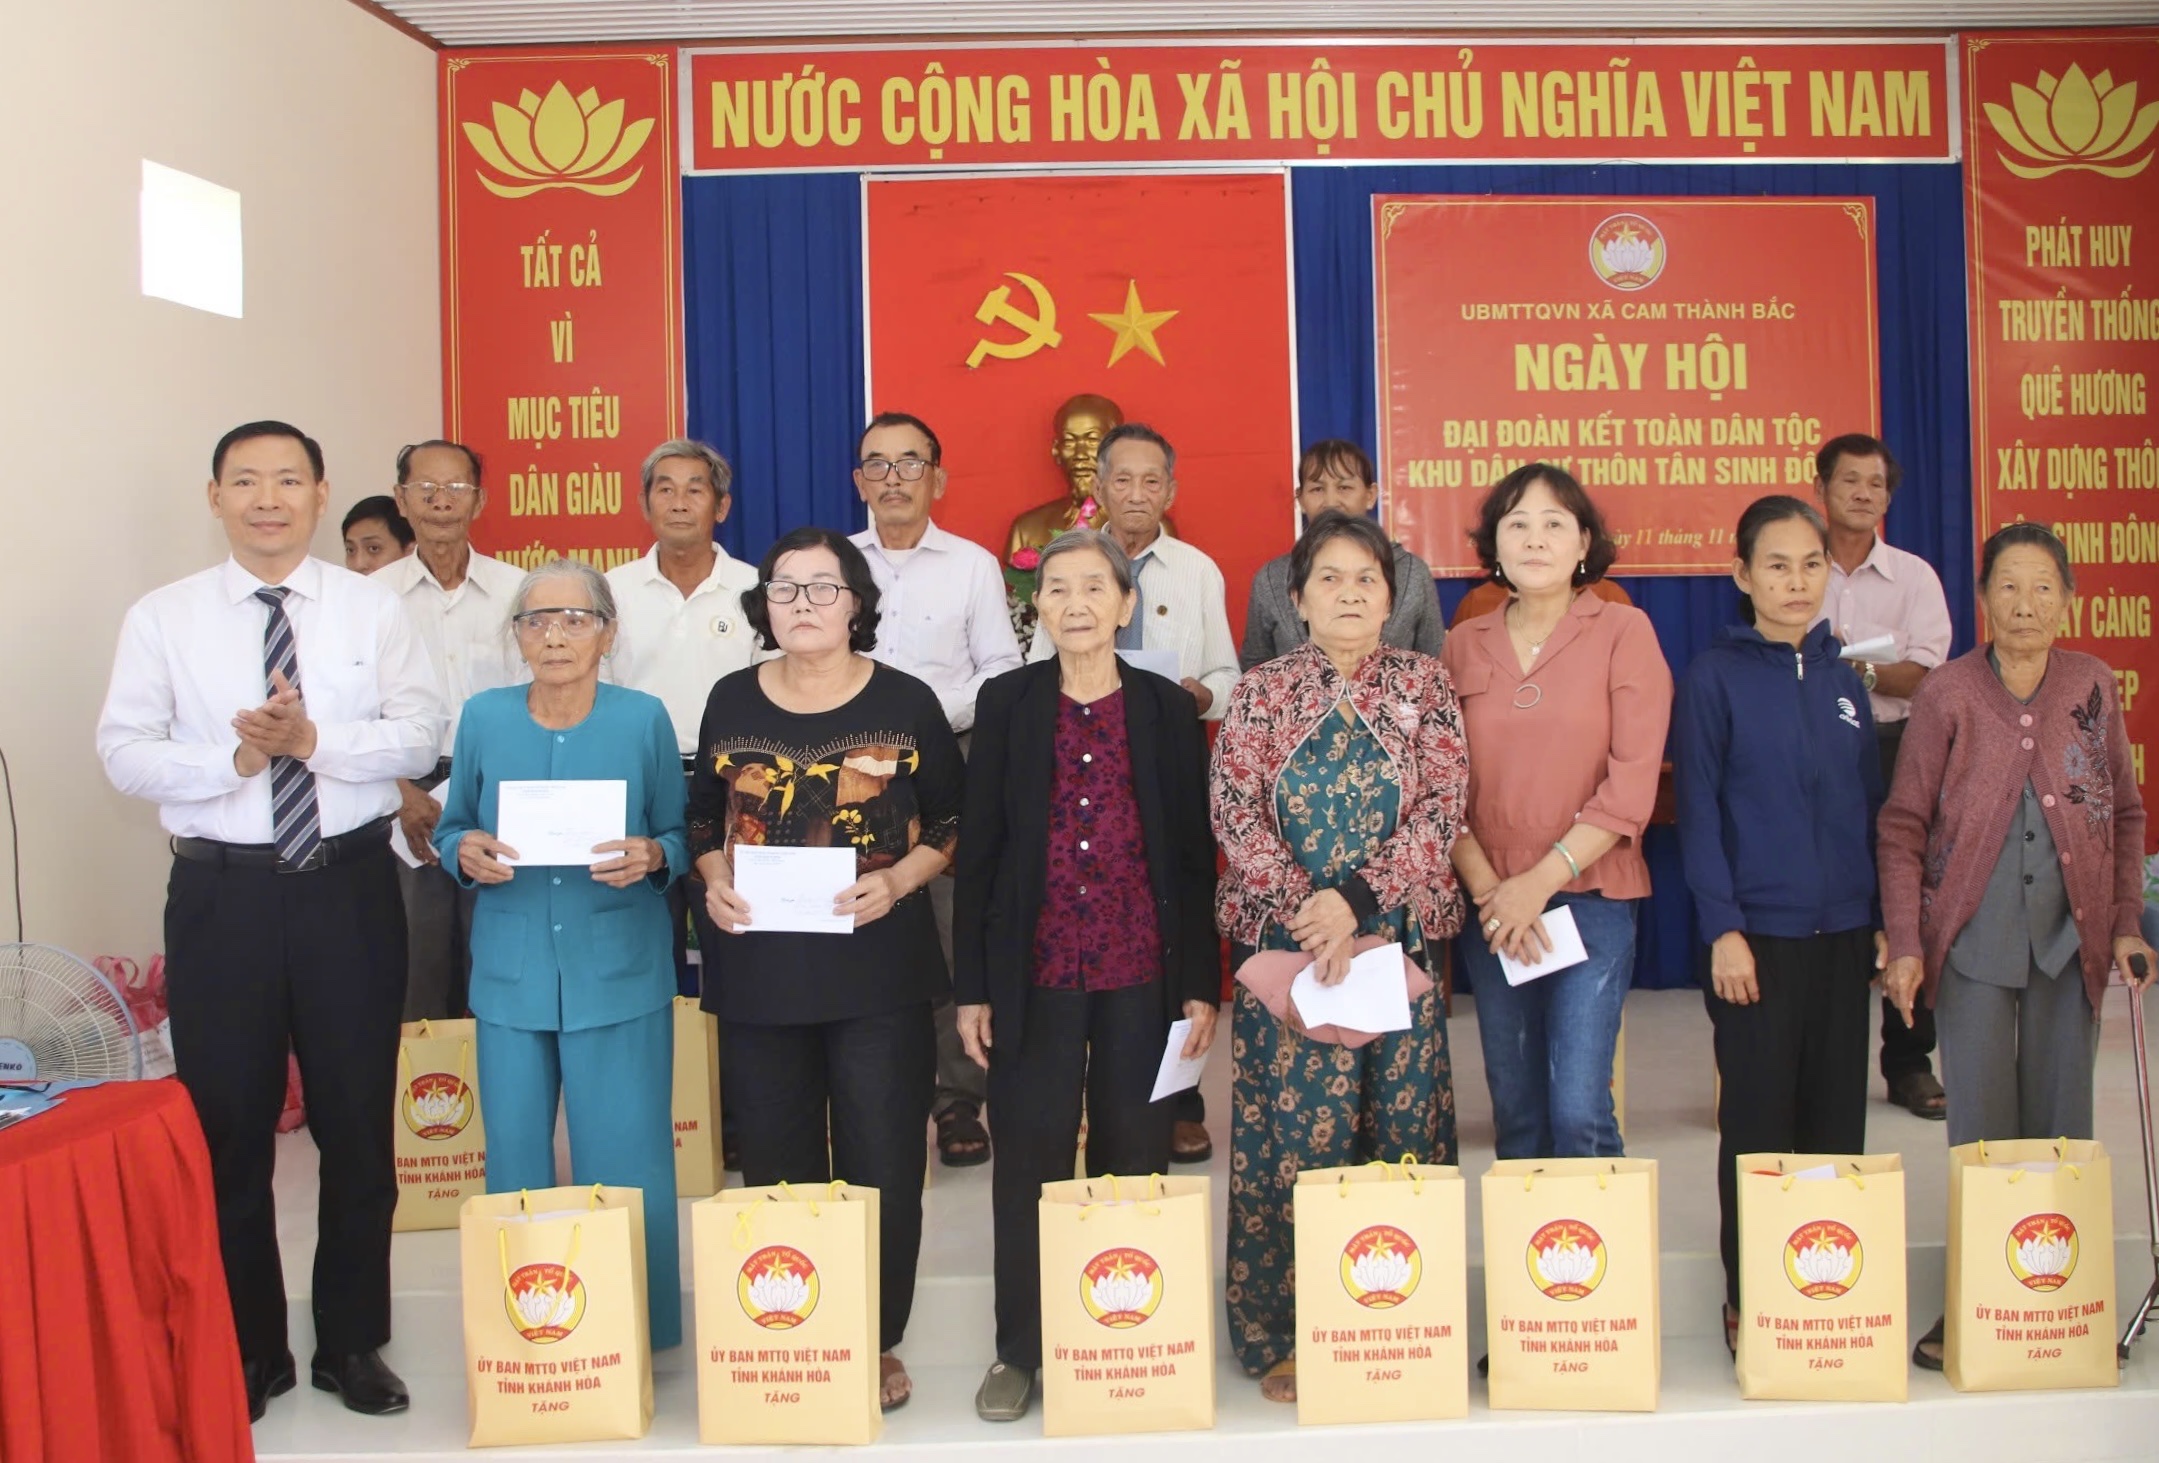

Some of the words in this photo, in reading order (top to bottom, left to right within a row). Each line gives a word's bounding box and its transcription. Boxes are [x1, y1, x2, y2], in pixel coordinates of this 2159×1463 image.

[711, 64, 861, 148] NƯỚC
[881, 61, 1030, 159] CỘNG
[1051, 57, 1161, 142] HÒA
[1177, 59, 1251, 140] XÃ
[1269, 57, 1356, 155] HỘI
[1377, 48, 1482, 139] CHỦ
[1502, 57, 1667, 138] NGHĨA
[1681, 56, 1791, 152] VIỆT
[1809, 70, 1931, 136] NAM
[2026, 216, 2082, 267] PHÁT
[2090, 225, 2132, 266] HUY
[521, 230, 562, 287] TẤT
[570, 229, 601, 287] CẢ
[1461, 303, 1580, 320] UBMTTQVN
[1588, 300, 1615, 319] XÃ
[1621, 303, 1666, 319] CAM
[1674, 299, 1744, 319] THÀNH
[1753, 296, 1795, 319] BẮC
[1999, 285, 2084, 341] TRUYỀN
[2091, 284, 2159, 341] THỐNG
[551, 311, 573, 362] VÌ
[1515, 333, 1648, 391] NGÀY
[1666, 333, 1747, 401] HỘI
[2021, 365, 2064, 420] QUÊ
[2071, 369, 2146, 415] HƯƠNG
[508, 396, 561, 449] MỤC
[569, 387, 619, 438] TIÊU
[1443, 420, 1490, 454] ĐẠI
[1496, 413, 1569, 447] ĐOÀN
[1578, 410, 1625, 446] KẾT
[1633, 412, 1702, 446] TOÀN
[1711, 412, 1764, 446] DÂN
[1772, 412, 1821, 451] TỘC
[1408, 459, 1462, 487] KHU
[1577, 452, 1646, 486] THÔN
[1655, 452, 1705, 485] TÂN
[1714, 456, 1776, 484] SINH
[1785, 451, 1817, 484] ĐÔ
[1998, 439, 2040, 490] XÂY
[2047, 444, 2108, 499] DỰNG
[2114, 438, 2159, 489] THÔ
[510, 464, 558, 516] DÂN
[566, 462, 621, 515] GIÀU
[1636, 529, 1652, 544] 11
[1658, 529, 1703, 548] tháng
[1709, 528, 1723, 544] 11
[2110, 513, 2159, 563] ĐÔN
[2091, 587, 2150, 637] CÀNG
[0, 1062, 22, 1071] ENKO
[675, 1120, 698, 1132] NAM
[397, 1158, 417, 1168] BAN
[421, 1156, 448, 1167] MTTQ
[452, 1153, 474, 1165] VIỆT
[398, 1172, 421, 1184] TỈNH
[425, 1171, 460, 1182] KHÁNH
[428, 1188, 459, 1201] TẶNG
[1976, 1303, 1990, 1320] ỦY
[1995, 1309, 2019, 1322] BAN
[2024, 1309, 2054, 1322] MTTQ
[2058, 1305, 2079, 1323] VIỆT
[2082, 1300, 2104, 1316] NAM
[1501, 1315, 1514, 1331] ỦY
[1519, 1320, 1542, 1332] BAN
[1547, 1320, 1577, 1333] MTTQ
[1582, 1317, 1605, 1335] VIỆT
[1610, 1318, 1637, 1331] NAM
[1758, 1312, 1770, 1329] ỦY
[1775, 1318, 1799, 1330] BAN
[1803, 1319, 1834, 1331] MTTQ
[1838, 1315, 1861, 1331] VIỆT
[1866, 1314, 1892, 1327] NAM
[1313, 1326, 1327, 1342] ỦY
[1331, 1329, 1356, 1342] BAN
[1360, 1328, 1391, 1341] MTTQ
[1395, 1325, 1420, 1341] VIỆT
[1424, 1326, 1451, 1338] NAM
[1776, 1334, 1803, 1350] TỈNH
[1807, 1336, 1846, 1349] KHÁNH
[1851, 1333, 1873, 1348] HÒA
[1996, 1325, 2022, 1341] TỈNH
[2026, 1326, 2065, 1341] KHÁNH
[2069, 1324, 2089, 1337] HÒA
[1055, 1344, 1069, 1360] ỦY
[1073, 1350, 1097, 1361] BAN
[1102, 1349, 1133, 1361] MTTQ
[1139, 1345, 1163, 1360] VIỆT
[1168, 1341, 1195, 1355] NAM
[1333, 1347, 1359, 1362] TỈNH
[1364, 1347, 1404, 1361] KHÁNH
[1409, 1346, 1432, 1359] HÒA
[1520, 1336, 1547, 1353] TỈNH
[1551, 1338, 1591, 1353] KHÁNH
[1595, 1338, 1618, 1352] HÒA
[478, 1356, 492, 1373] ỦY
[497, 1361, 520, 1374] BAN
[525, 1361, 556, 1375] MTTQ
[561, 1356, 587, 1375] VIỆT
[592, 1353, 621, 1370] NAM
[711, 1346, 725, 1362] ỦY
[730, 1350, 753, 1362] BAN
[758, 1350, 789, 1363] MTTQ
[794, 1348, 817, 1364] VIỆT
[823, 1349, 850, 1361] NAM
[2027, 1348, 2062, 1361] TẶNG
[1075, 1365, 1102, 1381] TỈNH
[1107, 1366, 1147, 1380] KHÁNH
[1152, 1363, 1176, 1377] HÒA
[1553, 1361, 1588, 1375] TẶNG
[1809, 1358, 1844, 1371] TẶNG
[497, 1377, 524, 1394] TỈNH
[529, 1380, 571, 1394] KHÁNH
[576, 1375, 601, 1390] HÒA
[732, 1367, 758, 1383] TỈNH
[763, 1368, 803, 1383] KHÁNH
[807, 1368, 831, 1382] HÒA
[1366, 1369, 1401, 1383] TẶNG
[765, 1392, 800, 1405] TẶNG
[1109, 1388, 1145, 1400] TẶNG
[532, 1400, 570, 1415] TẶNG
